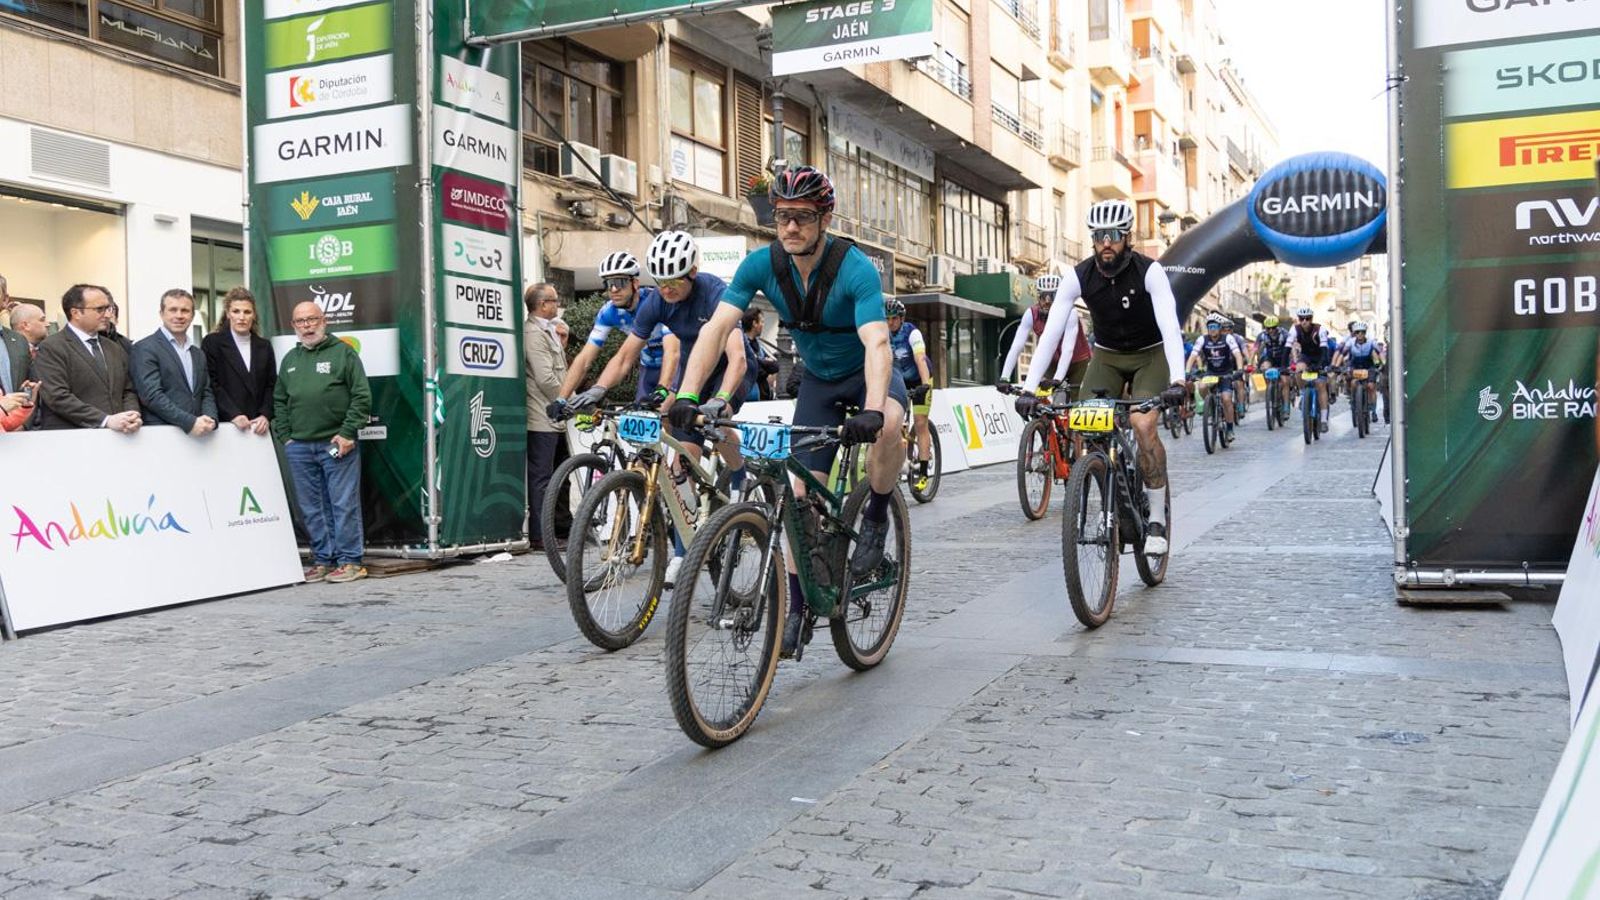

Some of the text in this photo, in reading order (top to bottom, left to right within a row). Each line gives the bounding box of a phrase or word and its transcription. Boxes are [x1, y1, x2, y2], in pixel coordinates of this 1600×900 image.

[806, 0, 896, 23] STAGE 3
[101, 15, 214, 60] MURIANA
[832, 20, 869, 40] JAÉN
[823, 46, 880, 62] GARMIN
[319, 74, 367, 90] Diputación
[1496, 59, 1600, 89] SKO
[332, 85, 367, 99] Córdoba
[278, 128, 382, 161] GARMIN
[443, 129, 507, 162] GARMIN
[1499, 129, 1600, 167] PIRE
[322, 192, 373, 207] CAJA RURAL
[463, 189, 505, 211] IMDECO
[1263, 191, 1374, 214] GARMIN
[337, 205, 359, 217] JAÉN
[1161, 265, 1206, 275] armin.com
[314, 292, 355, 313] NDL
[456, 284, 502, 307] POWER
[477, 302, 503, 321] ADE
[462, 342, 498, 364] CRUZ
[974, 404, 1012, 437] Jaén
[1073, 410, 1109, 427] 217-1
[1513, 402, 1558, 419] BIKE
[470, 390, 496, 458] 15
[623, 418, 658, 439] 420-2
[743, 426, 784, 453] 420-1
[10, 494, 191, 552] Andalucía
